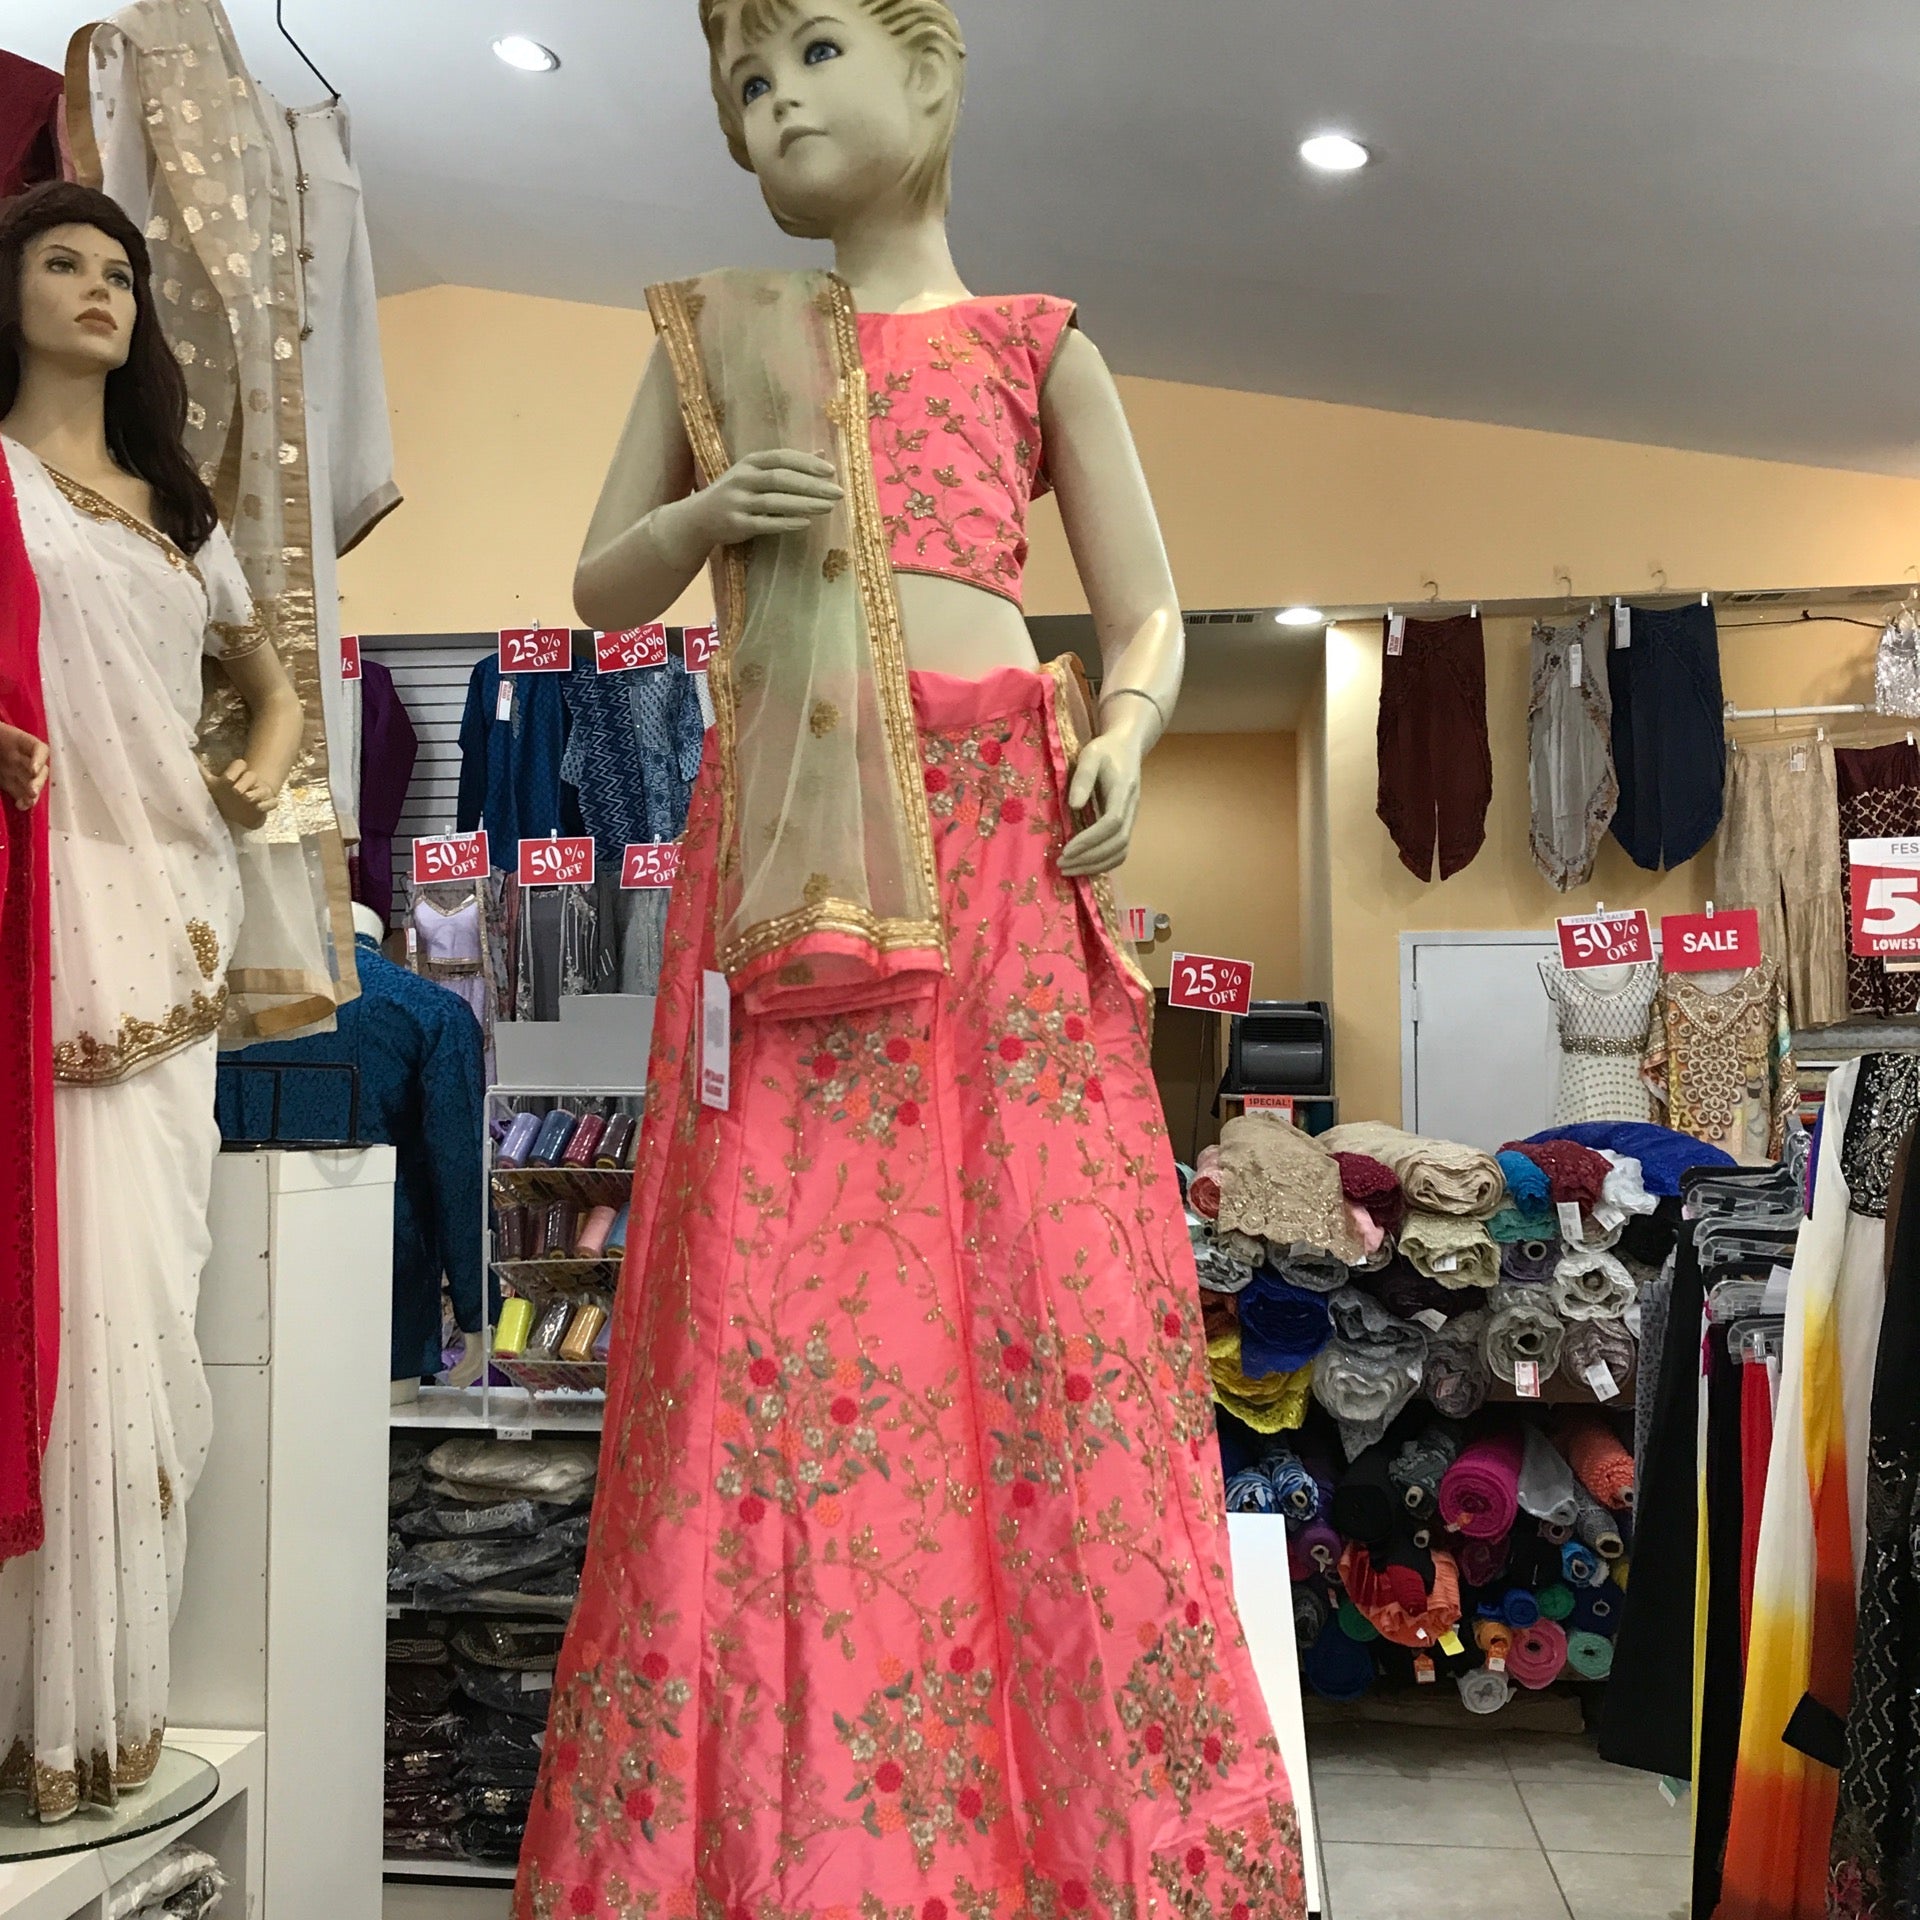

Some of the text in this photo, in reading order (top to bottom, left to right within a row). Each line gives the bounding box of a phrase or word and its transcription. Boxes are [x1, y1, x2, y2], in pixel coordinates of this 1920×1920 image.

[507, 633, 561, 663] 25%
[533, 650, 558, 667] OFF
[599, 627, 642, 660] Buy One
[621, 633, 664, 667] 50%
[342, 657, 354, 671] ls
[426, 840, 480, 874] 50%
[451, 857, 478, 876] OFF
[531, 843, 585, 876] 50%
[555, 862, 583, 880] OFF
[631, 848, 683, 879] 25%
[653, 866, 679, 884] OFF
[1129, 908, 1147, 939] IT
[1573, 919, 1639, 958] 50%
[1607, 938, 1639, 961] OFF
[1682, 929, 1739, 953] SALE
[1181, 963, 1242, 997] 25%
[1208, 988, 1238, 1006] OFF
